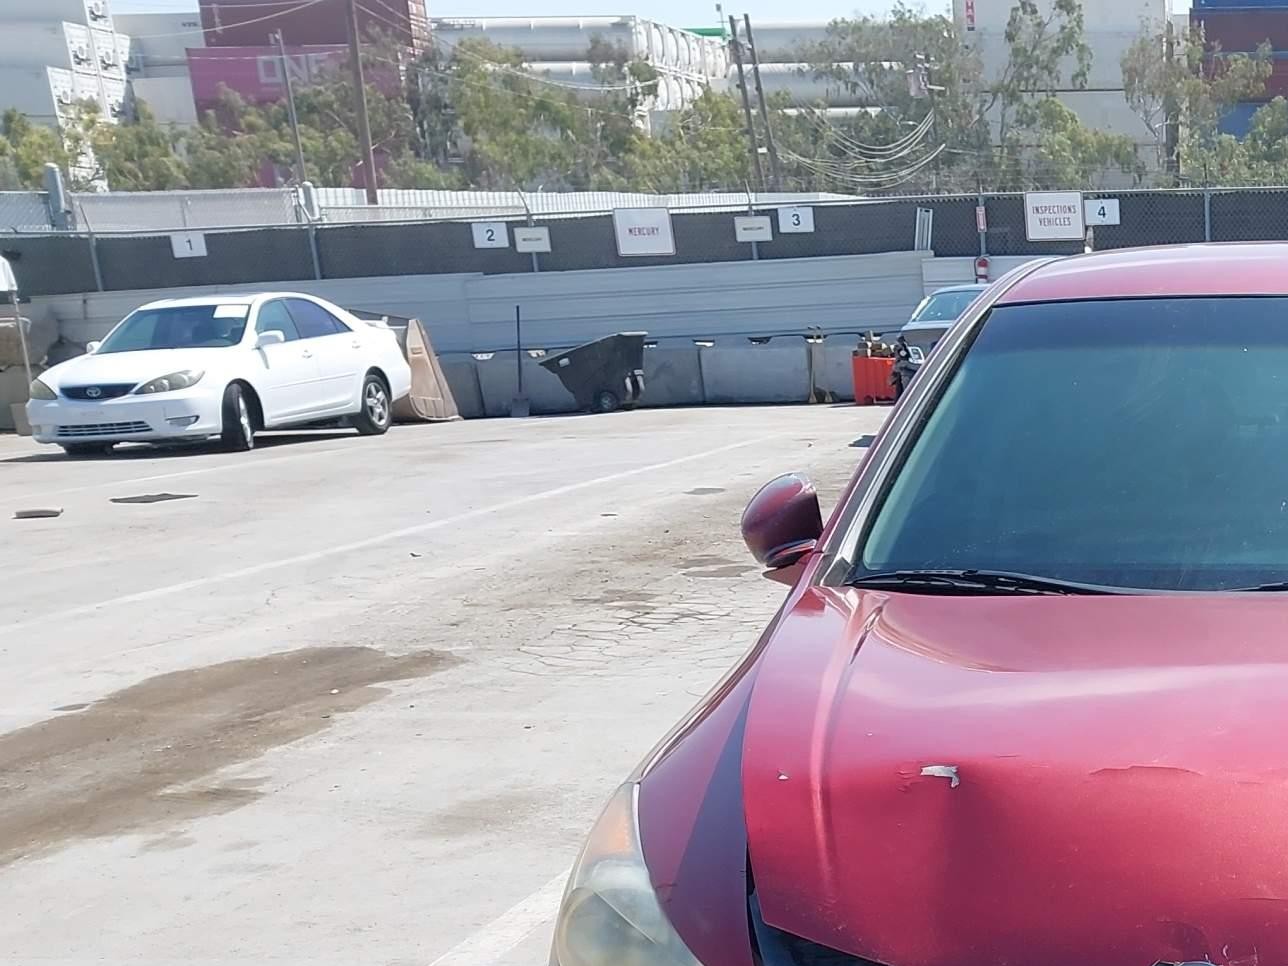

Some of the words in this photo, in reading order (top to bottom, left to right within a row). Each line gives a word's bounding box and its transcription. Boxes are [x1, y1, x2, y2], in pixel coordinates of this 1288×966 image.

[1031, 204, 1077, 214] INSPECTIONS
[1097, 206, 1106, 218] 4
[791, 213, 801, 226] 3
[1038, 217, 1072, 226] VEHICLES
[486, 228, 495, 241] 2
[628, 226, 659, 236] MERCURY
[186, 239, 193, 251] 1
